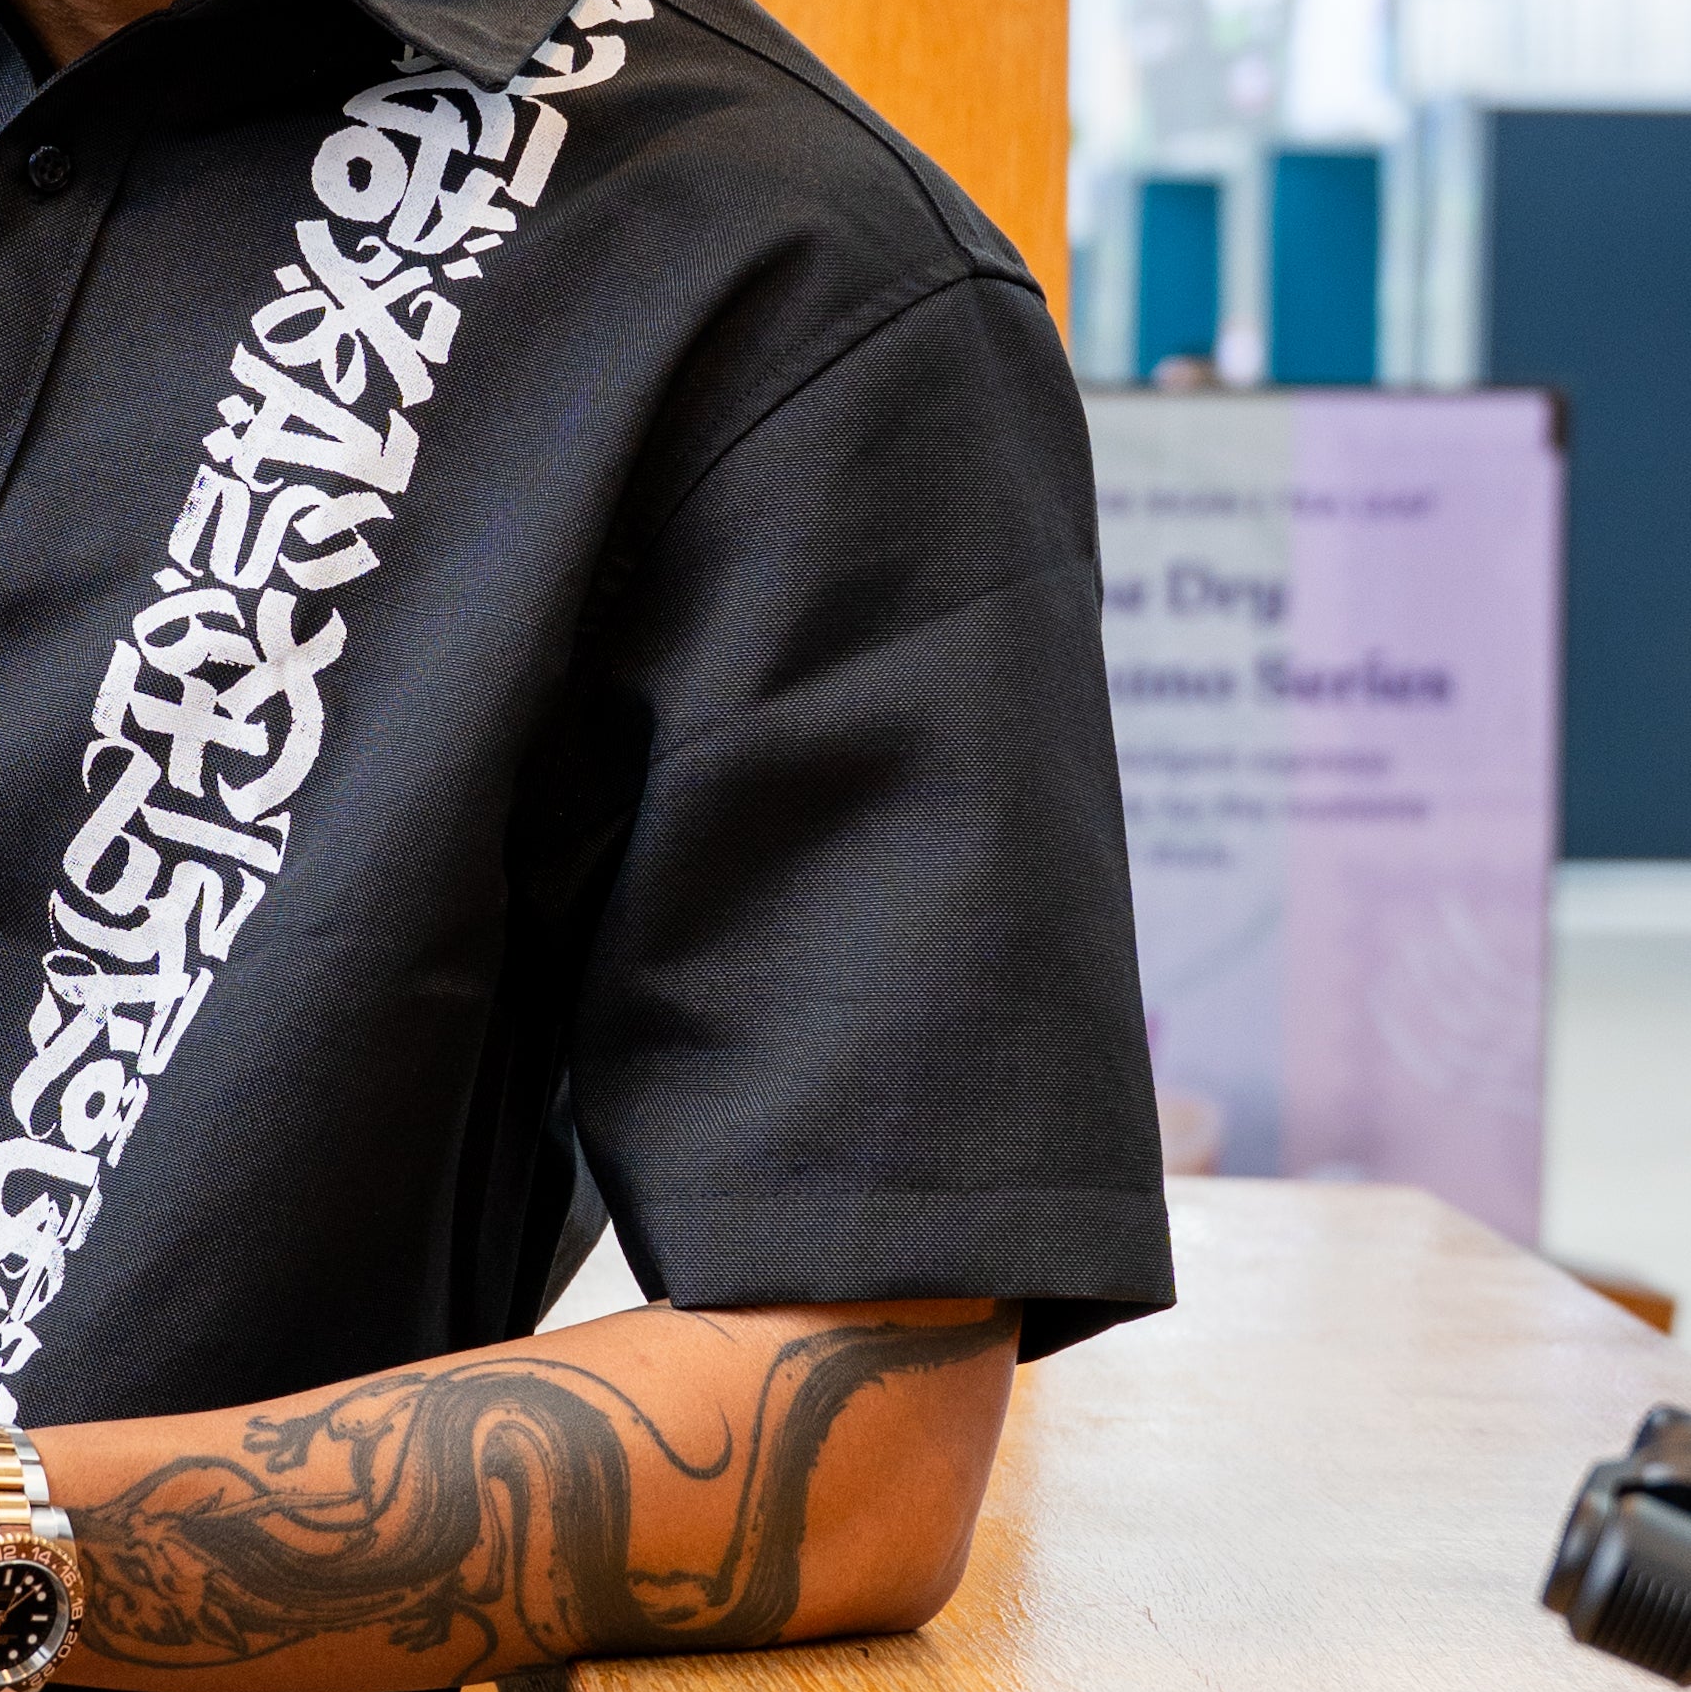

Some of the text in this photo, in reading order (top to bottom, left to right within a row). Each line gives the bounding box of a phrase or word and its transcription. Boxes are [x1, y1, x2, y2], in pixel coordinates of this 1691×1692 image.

[1165, 560, 1287, 626] Dry
[1256, 649, 1453, 705] Series
[31, 1546, 52, 1565] 14
[59, 1564, 77, 1588] 16
[70, 1597, 83, 1620] 18
[58, 1631, 78, 1659] 20
